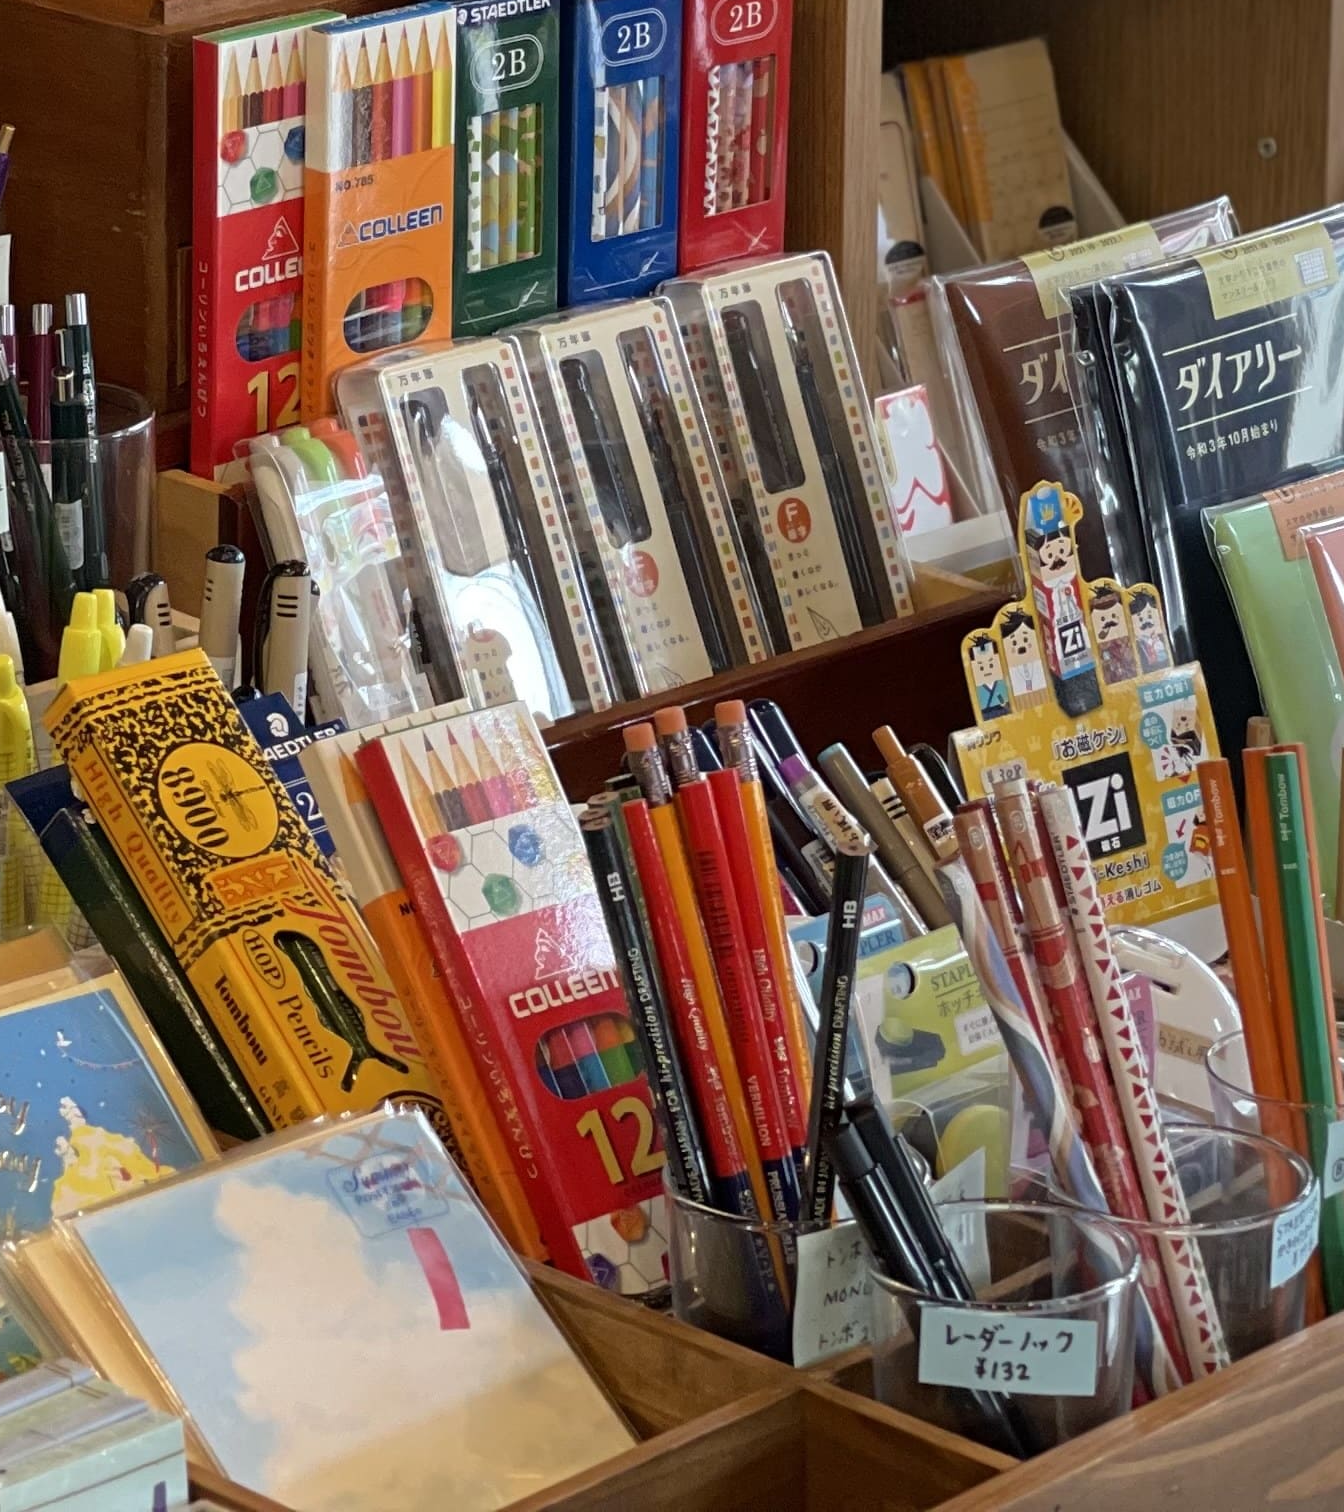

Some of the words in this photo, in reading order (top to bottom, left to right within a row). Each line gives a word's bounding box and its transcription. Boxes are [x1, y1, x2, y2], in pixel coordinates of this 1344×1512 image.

[729, 0, 763, 33] 2B
[616, 21, 652, 54] 2B
[492, 47, 527, 81] 2B
[358, 204, 444, 243] COLLEEN
[1175, 340, 1302, 412] ダイアリー
[247, 361, 303, 434] 12
[1185, 418, 1279, 461] 令和3年10月始まり
[1079, 774, 1132, 841] Zi
[606, 871, 626, 903] HB
[843, 899, 858, 930] HB
[863, 906, 886, 924] MAX
[507, 968, 621, 1021] COLLEEN
[276, 992, 335, 1080] Pencils
[746, 1075, 772, 1148] VERMILION
[575, 1096, 667, 1186] 12
[944, 1320, 1075, 1352] レーダーノック
[974, 1358, 1031, 1382] ¥132
